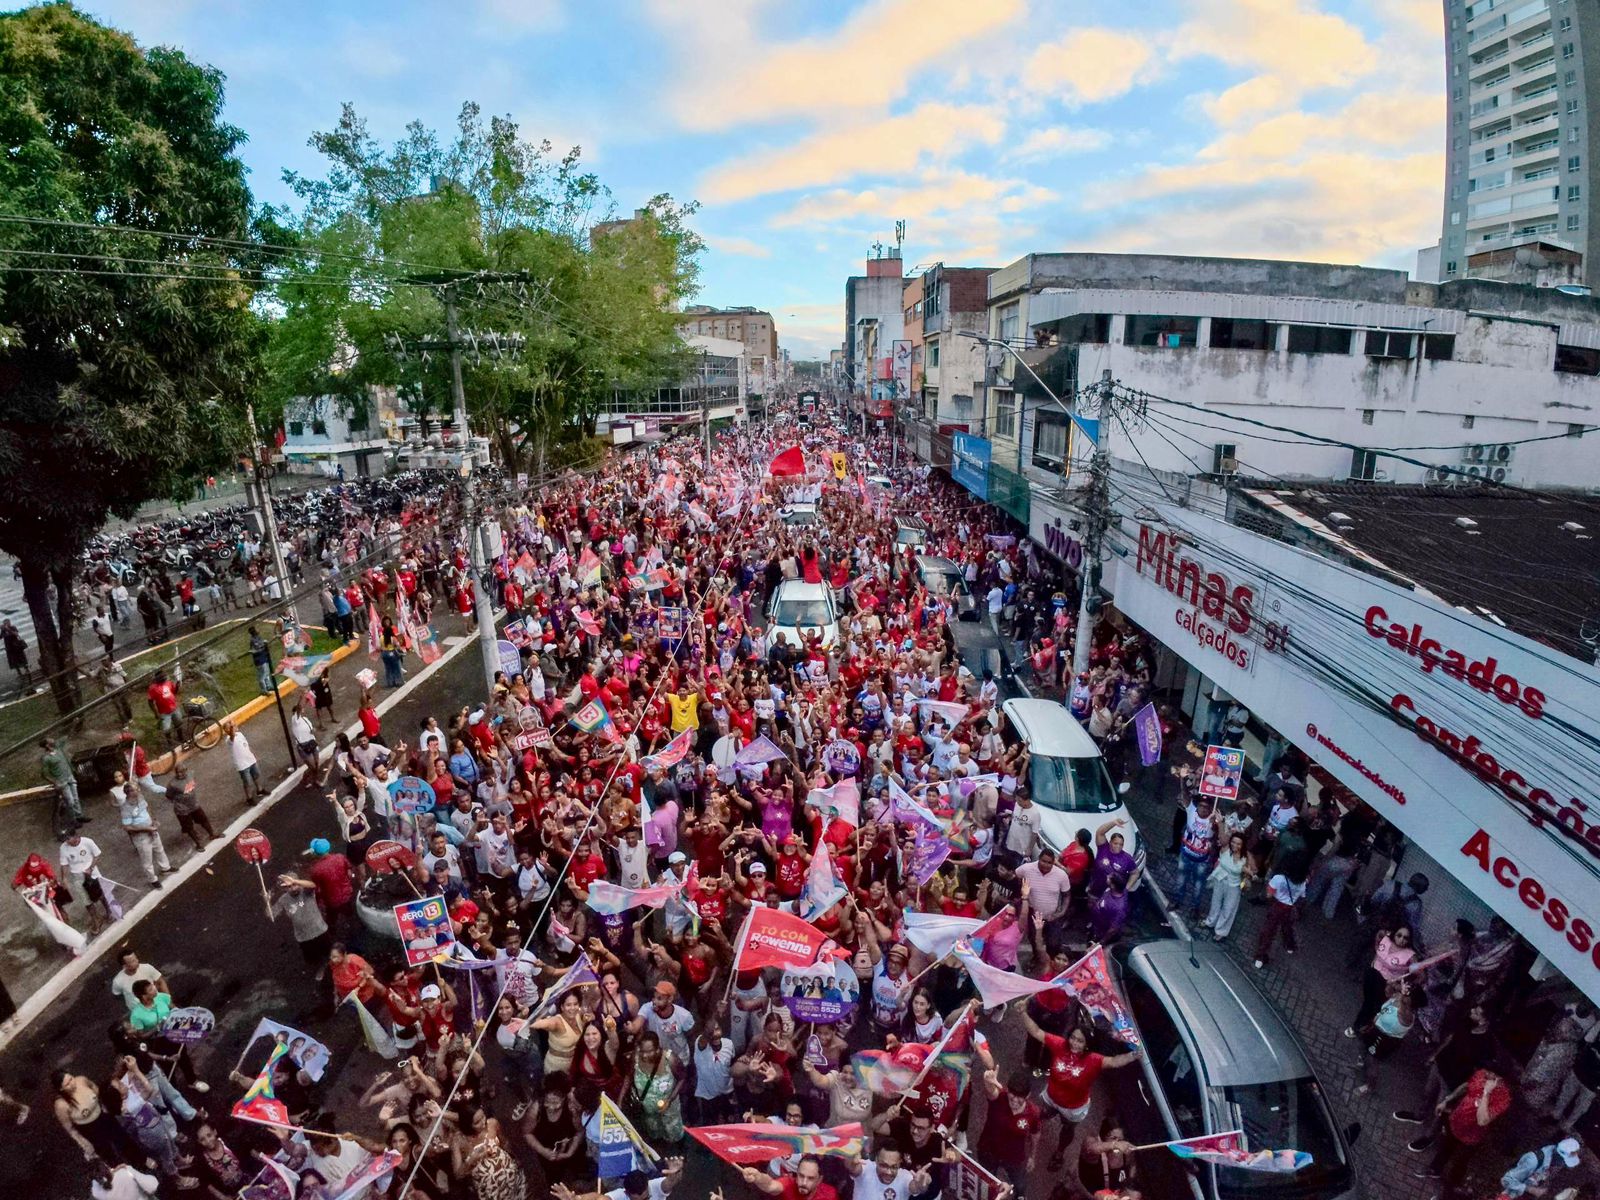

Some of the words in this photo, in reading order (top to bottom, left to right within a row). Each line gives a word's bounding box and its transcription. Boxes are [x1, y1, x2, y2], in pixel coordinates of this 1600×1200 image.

[1043, 517, 1083, 568] vivo
[1136, 524, 1255, 634] Minas
[1175, 607, 1250, 669] calçados
[1364, 606, 1547, 719] Calçados
[424, 903, 439, 918] 13
[750, 932, 812, 956] Rowenna
[780, 929, 809, 944] COM
